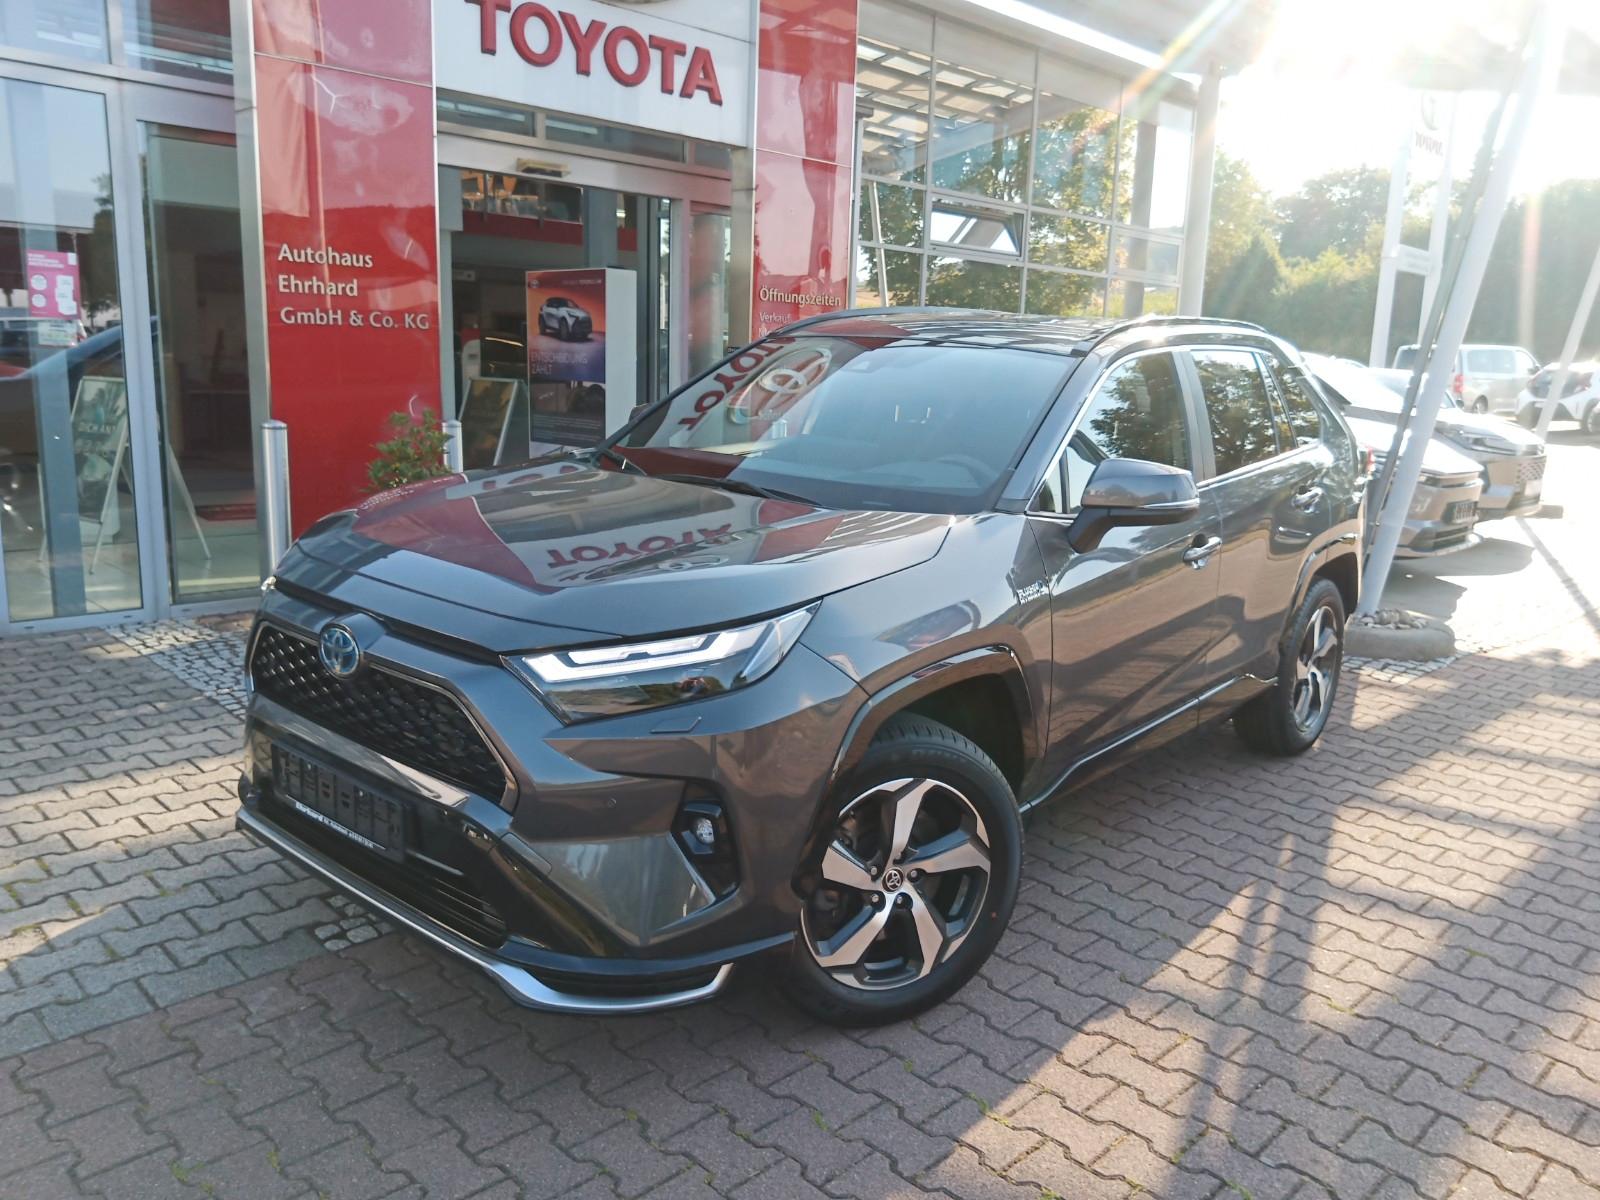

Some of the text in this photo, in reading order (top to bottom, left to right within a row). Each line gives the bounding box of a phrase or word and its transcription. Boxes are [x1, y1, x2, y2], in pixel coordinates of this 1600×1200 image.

[464, 0, 723, 106] TOYOTA
[278, 243, 374, 268] Autohaus
[278, 274, 358, 297] Ehrhard
[759, 284, 841, 308] Öffnungszeiten
[280, 306, 429, 330] GmbH & Co. KG
